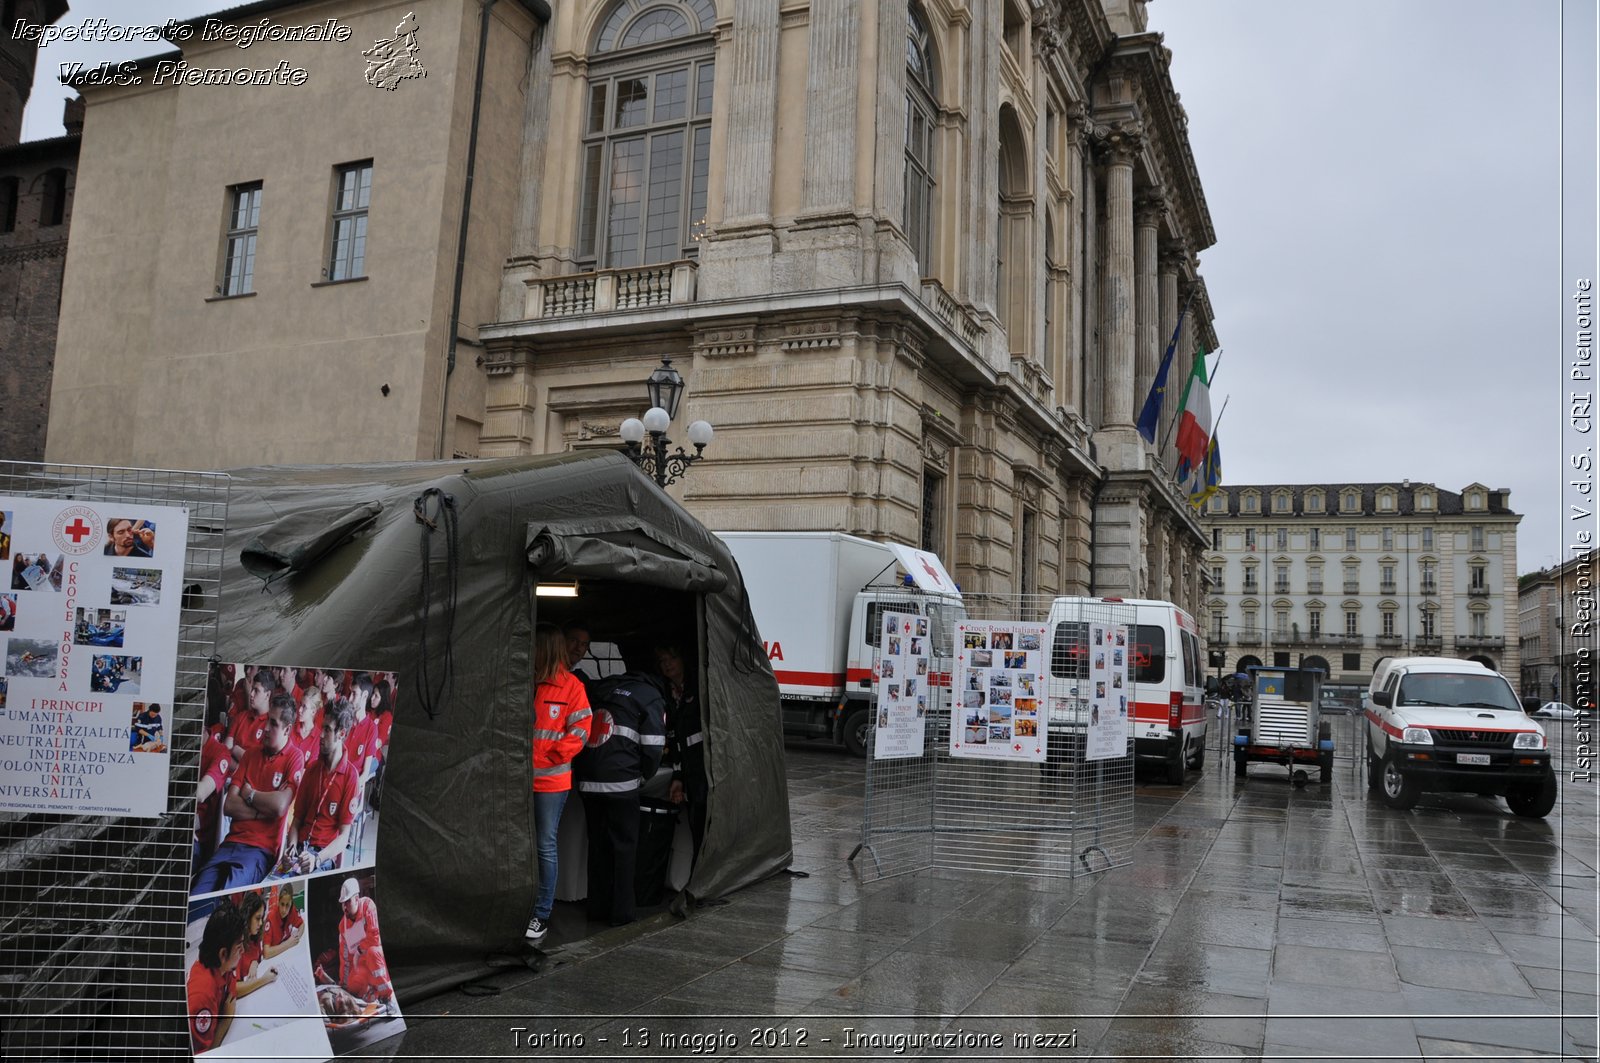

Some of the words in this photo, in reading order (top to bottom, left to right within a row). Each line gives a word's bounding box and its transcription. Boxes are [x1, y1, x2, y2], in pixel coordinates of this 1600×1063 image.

[66, 562, 79, 622] CROCE
[59, 631, 71, 692] ROSSA
[31, 699, 36, 709] I
[41, 699, 103, 712] PRINCIPI
[8, 710, 74, 723] UMANITÁ
[30, 724, 129, 739] IMPARZIALITÁ
[30, 749, 135, 764] INDIPENDENZA
[0, 760, 105, 775] OLONTARIATO
[41, 774, 84, 787] UNITÁ
